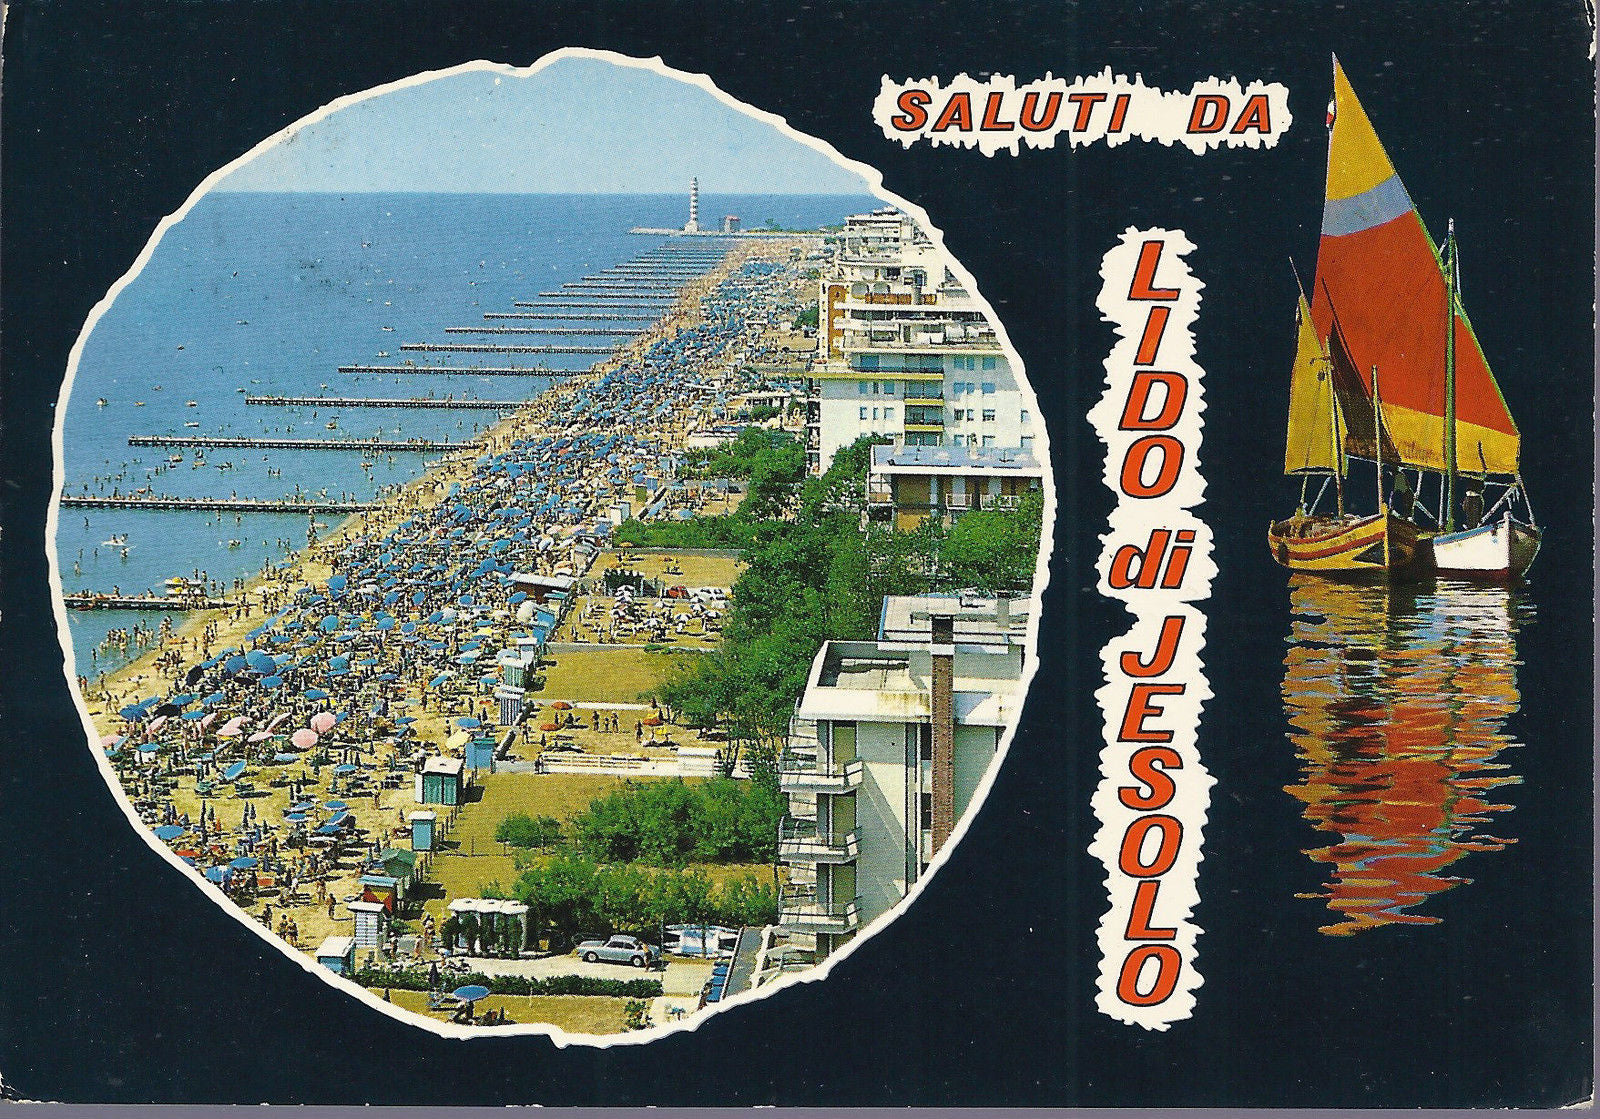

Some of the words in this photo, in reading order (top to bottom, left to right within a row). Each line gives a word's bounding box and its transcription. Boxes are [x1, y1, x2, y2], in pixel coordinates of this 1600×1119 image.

[891, 90, 1132, 134] SALUTI
[1187, 94, 1272, 134] DA
[1117, 240, 1189, 500] LIDO
[1107, 528, 1197, 590] di
[1116, 615, 1187, 1008] JESOLO
